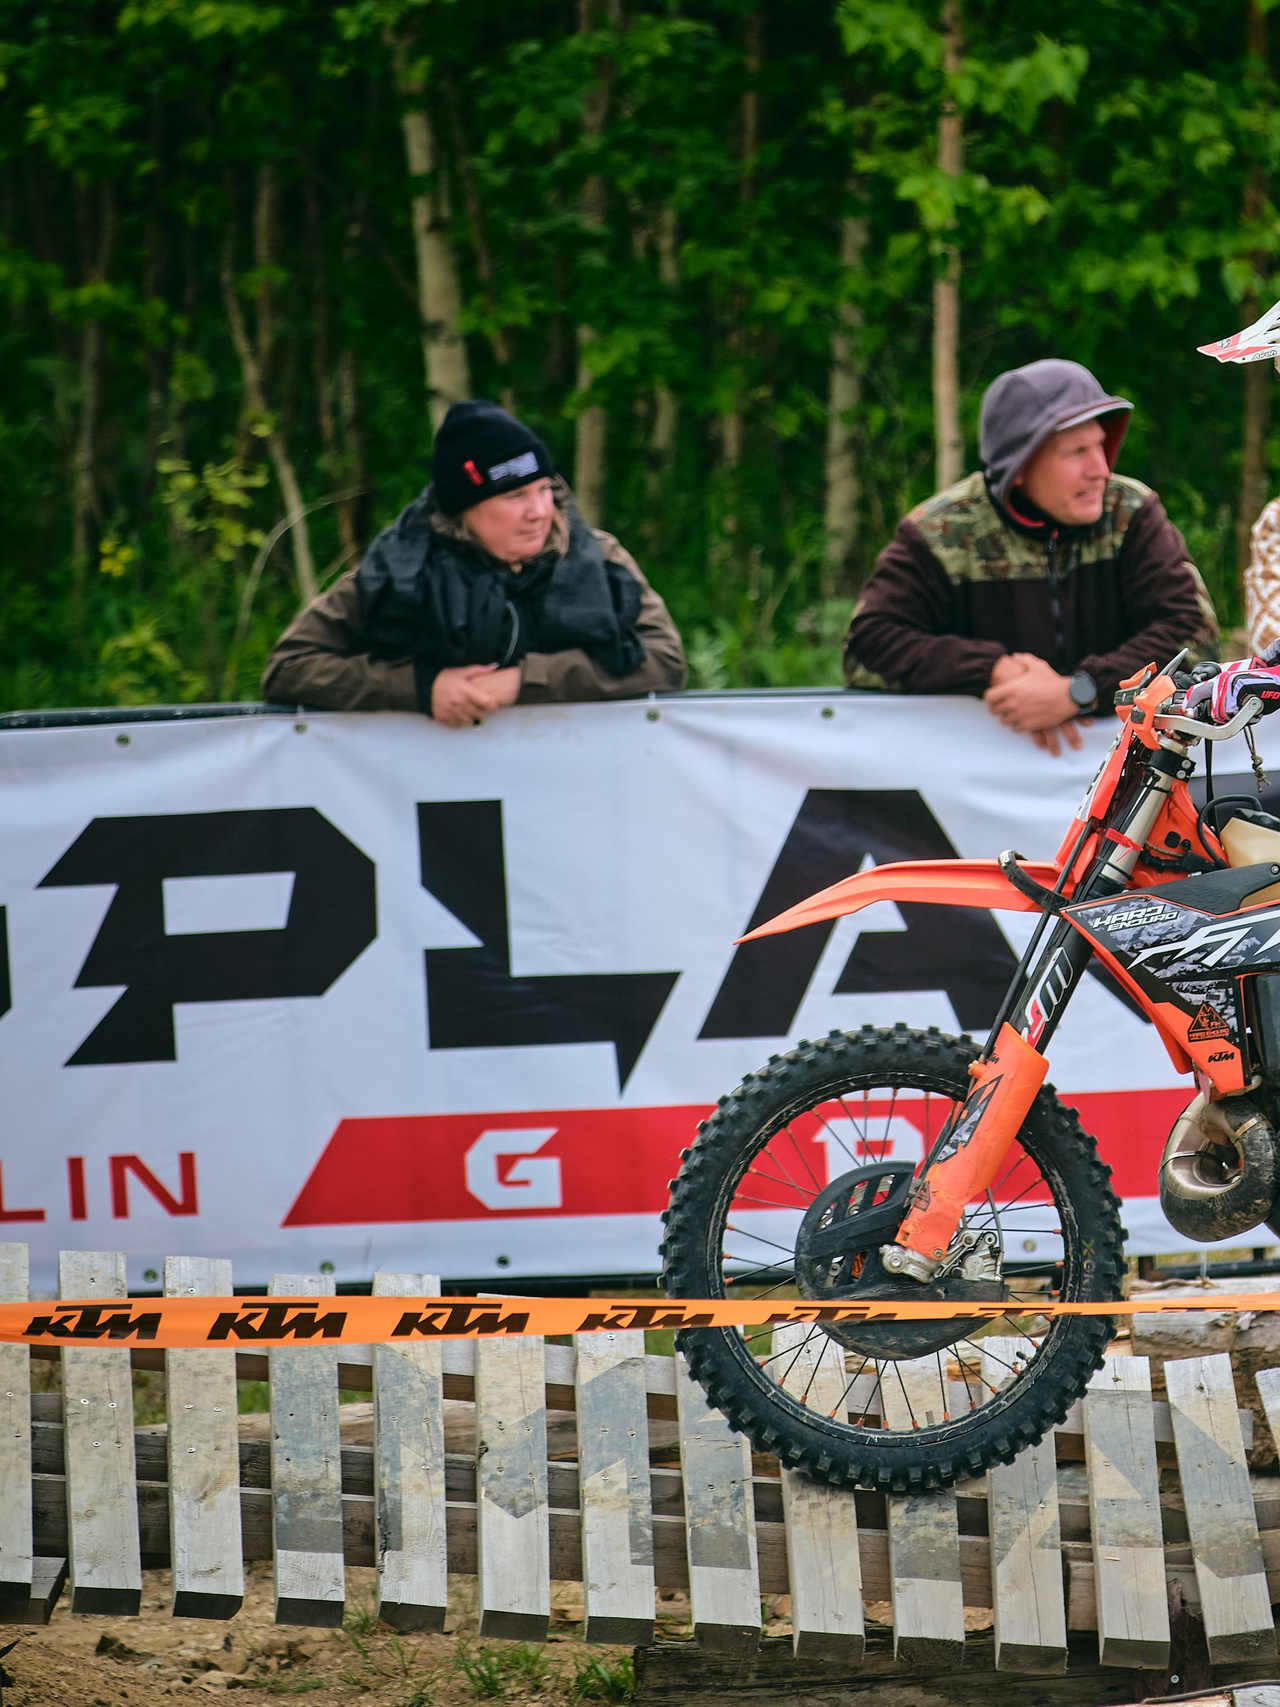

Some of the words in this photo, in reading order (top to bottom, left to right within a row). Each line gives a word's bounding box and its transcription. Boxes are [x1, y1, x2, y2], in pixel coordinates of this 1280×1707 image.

[1261, 690, 1280, 700] UFO
[1093, 904, 1166, 928] HARD
[1107, 911, 1178, 932] ENDURO
[1208, 1051, 1234, 1063] KTM
[22, 1304, 162, 1340] KTM
[207, 1303, 348, 1340] KTM
[391, 1303, 530, 1336] KTM
[576, 1305, 714, 1332] KTM
